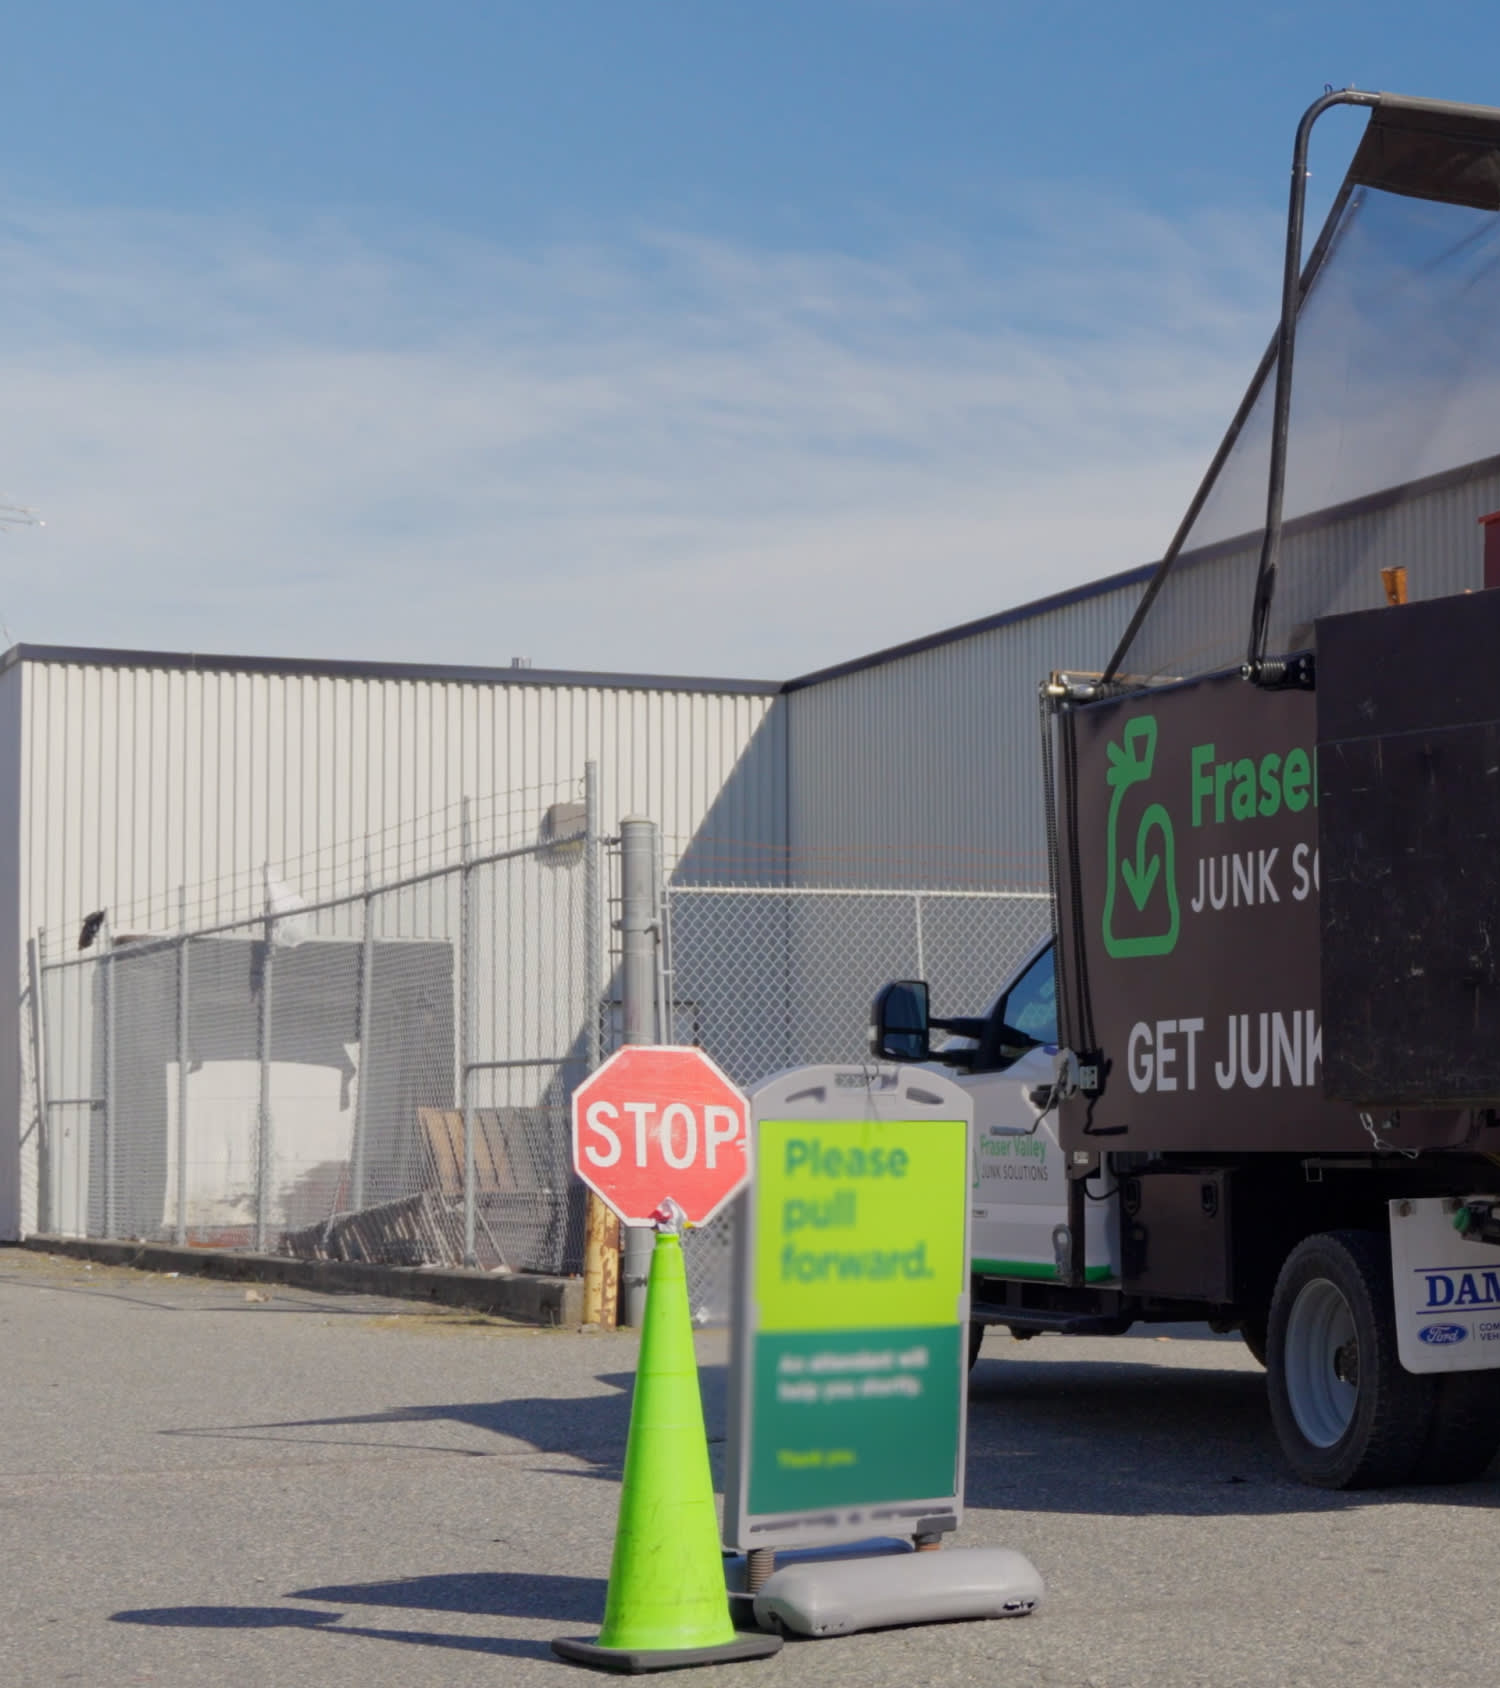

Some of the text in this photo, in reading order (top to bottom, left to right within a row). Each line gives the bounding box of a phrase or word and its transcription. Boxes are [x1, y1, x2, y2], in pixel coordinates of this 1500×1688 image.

[1191, 743, 1319, 828] Frase
[1190, 842, 1321, 913] JUNK S
[1127, 1009, 1323, 1094] GET JUNK
[584, 1100, 740, 1170] STOP
[980, 1133, 1047, 1164] Fraser Valley
[784, 1138, 909, 1179] Please
[981, 1163, 1049, 1181] JUNK SOLUTIONS
[782, 1189, 857, 1235] pull
[780, 1240, 935, 1281] forward.
[1426, 1325, 1459, 1342] Ford
